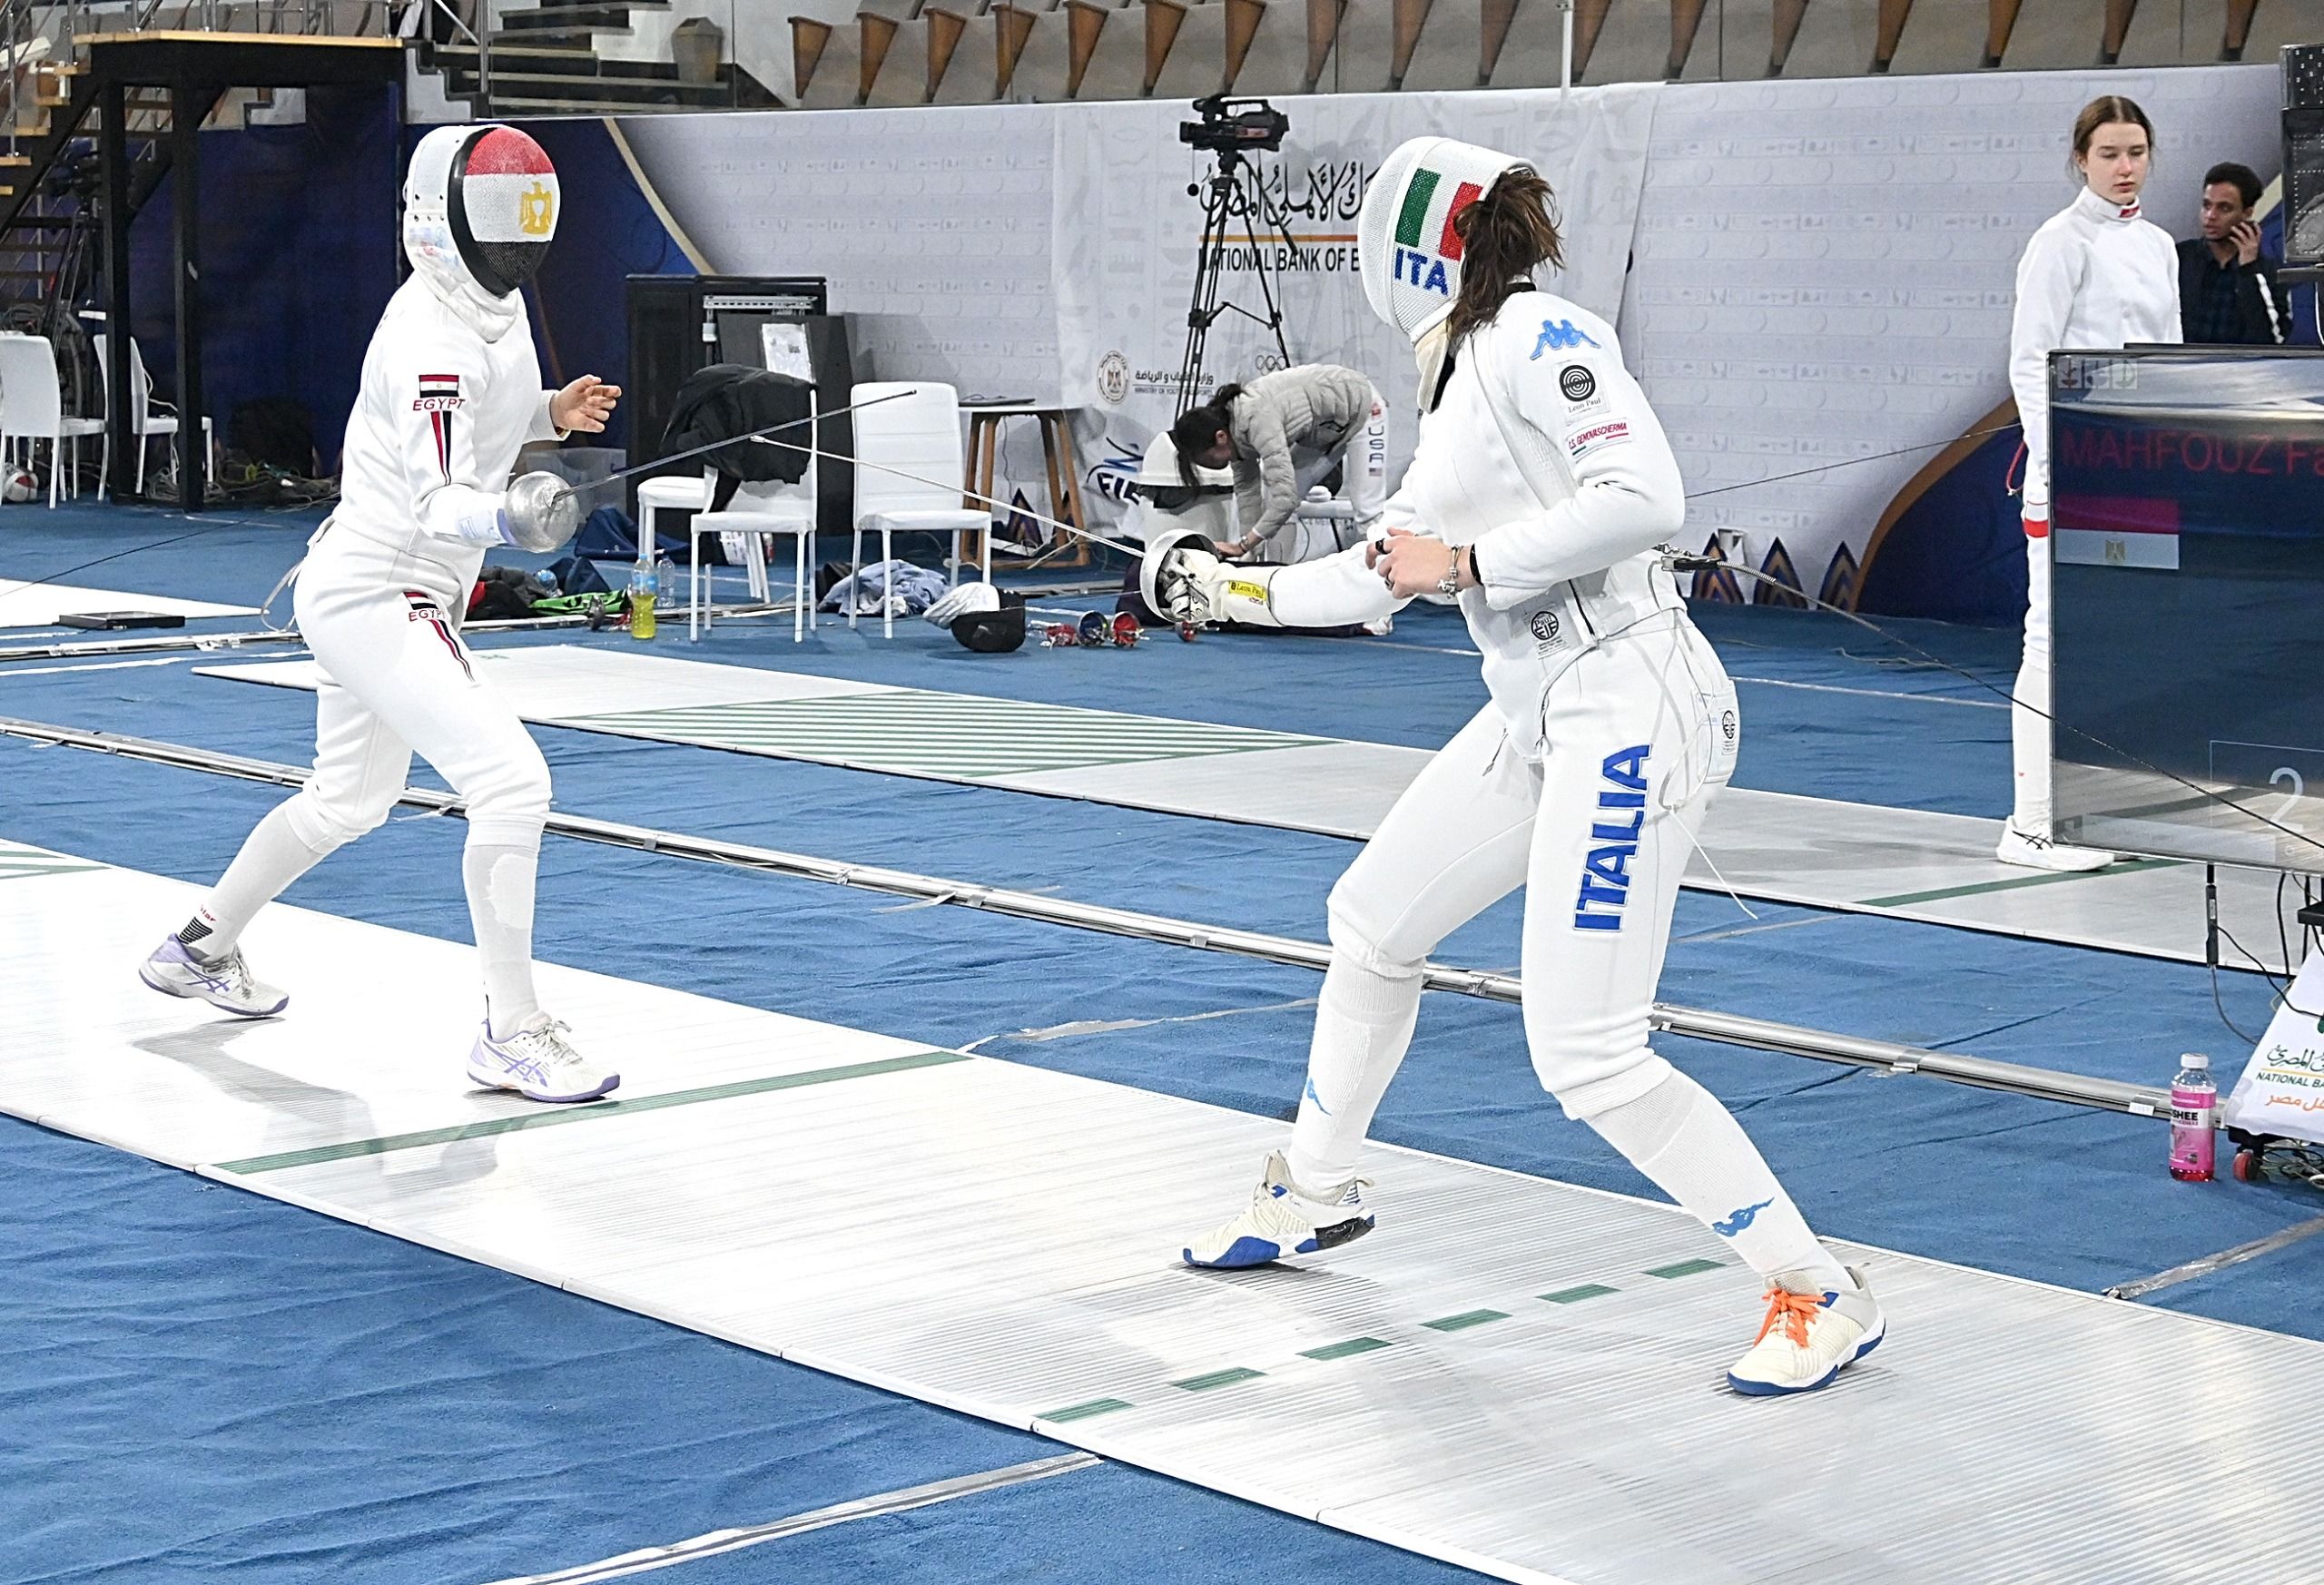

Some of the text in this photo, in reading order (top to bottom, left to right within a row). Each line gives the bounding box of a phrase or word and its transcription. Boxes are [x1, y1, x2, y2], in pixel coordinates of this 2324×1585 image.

[1277, 248, 1321, 271] BANK
[1325, 248, 1346, 271] OF
[1395, 248, 1448, 296] ITA
[412, 398, 466, 411] EGYPT
[1568, 403, 1585, 413] Leon
[1586, 398, 1601, 407] Paul
[1368, 425, 1384, 463] USA
[2062, 427, 2273, 475] MAHFOUZ
[2268, 767, 2304, 832] 2
[1571, 743, 1652, 932] ITALIA
[2256, 1072, 2309, 1087] NATIONAL
[2264, 1095, 2302, 1107] مصر
